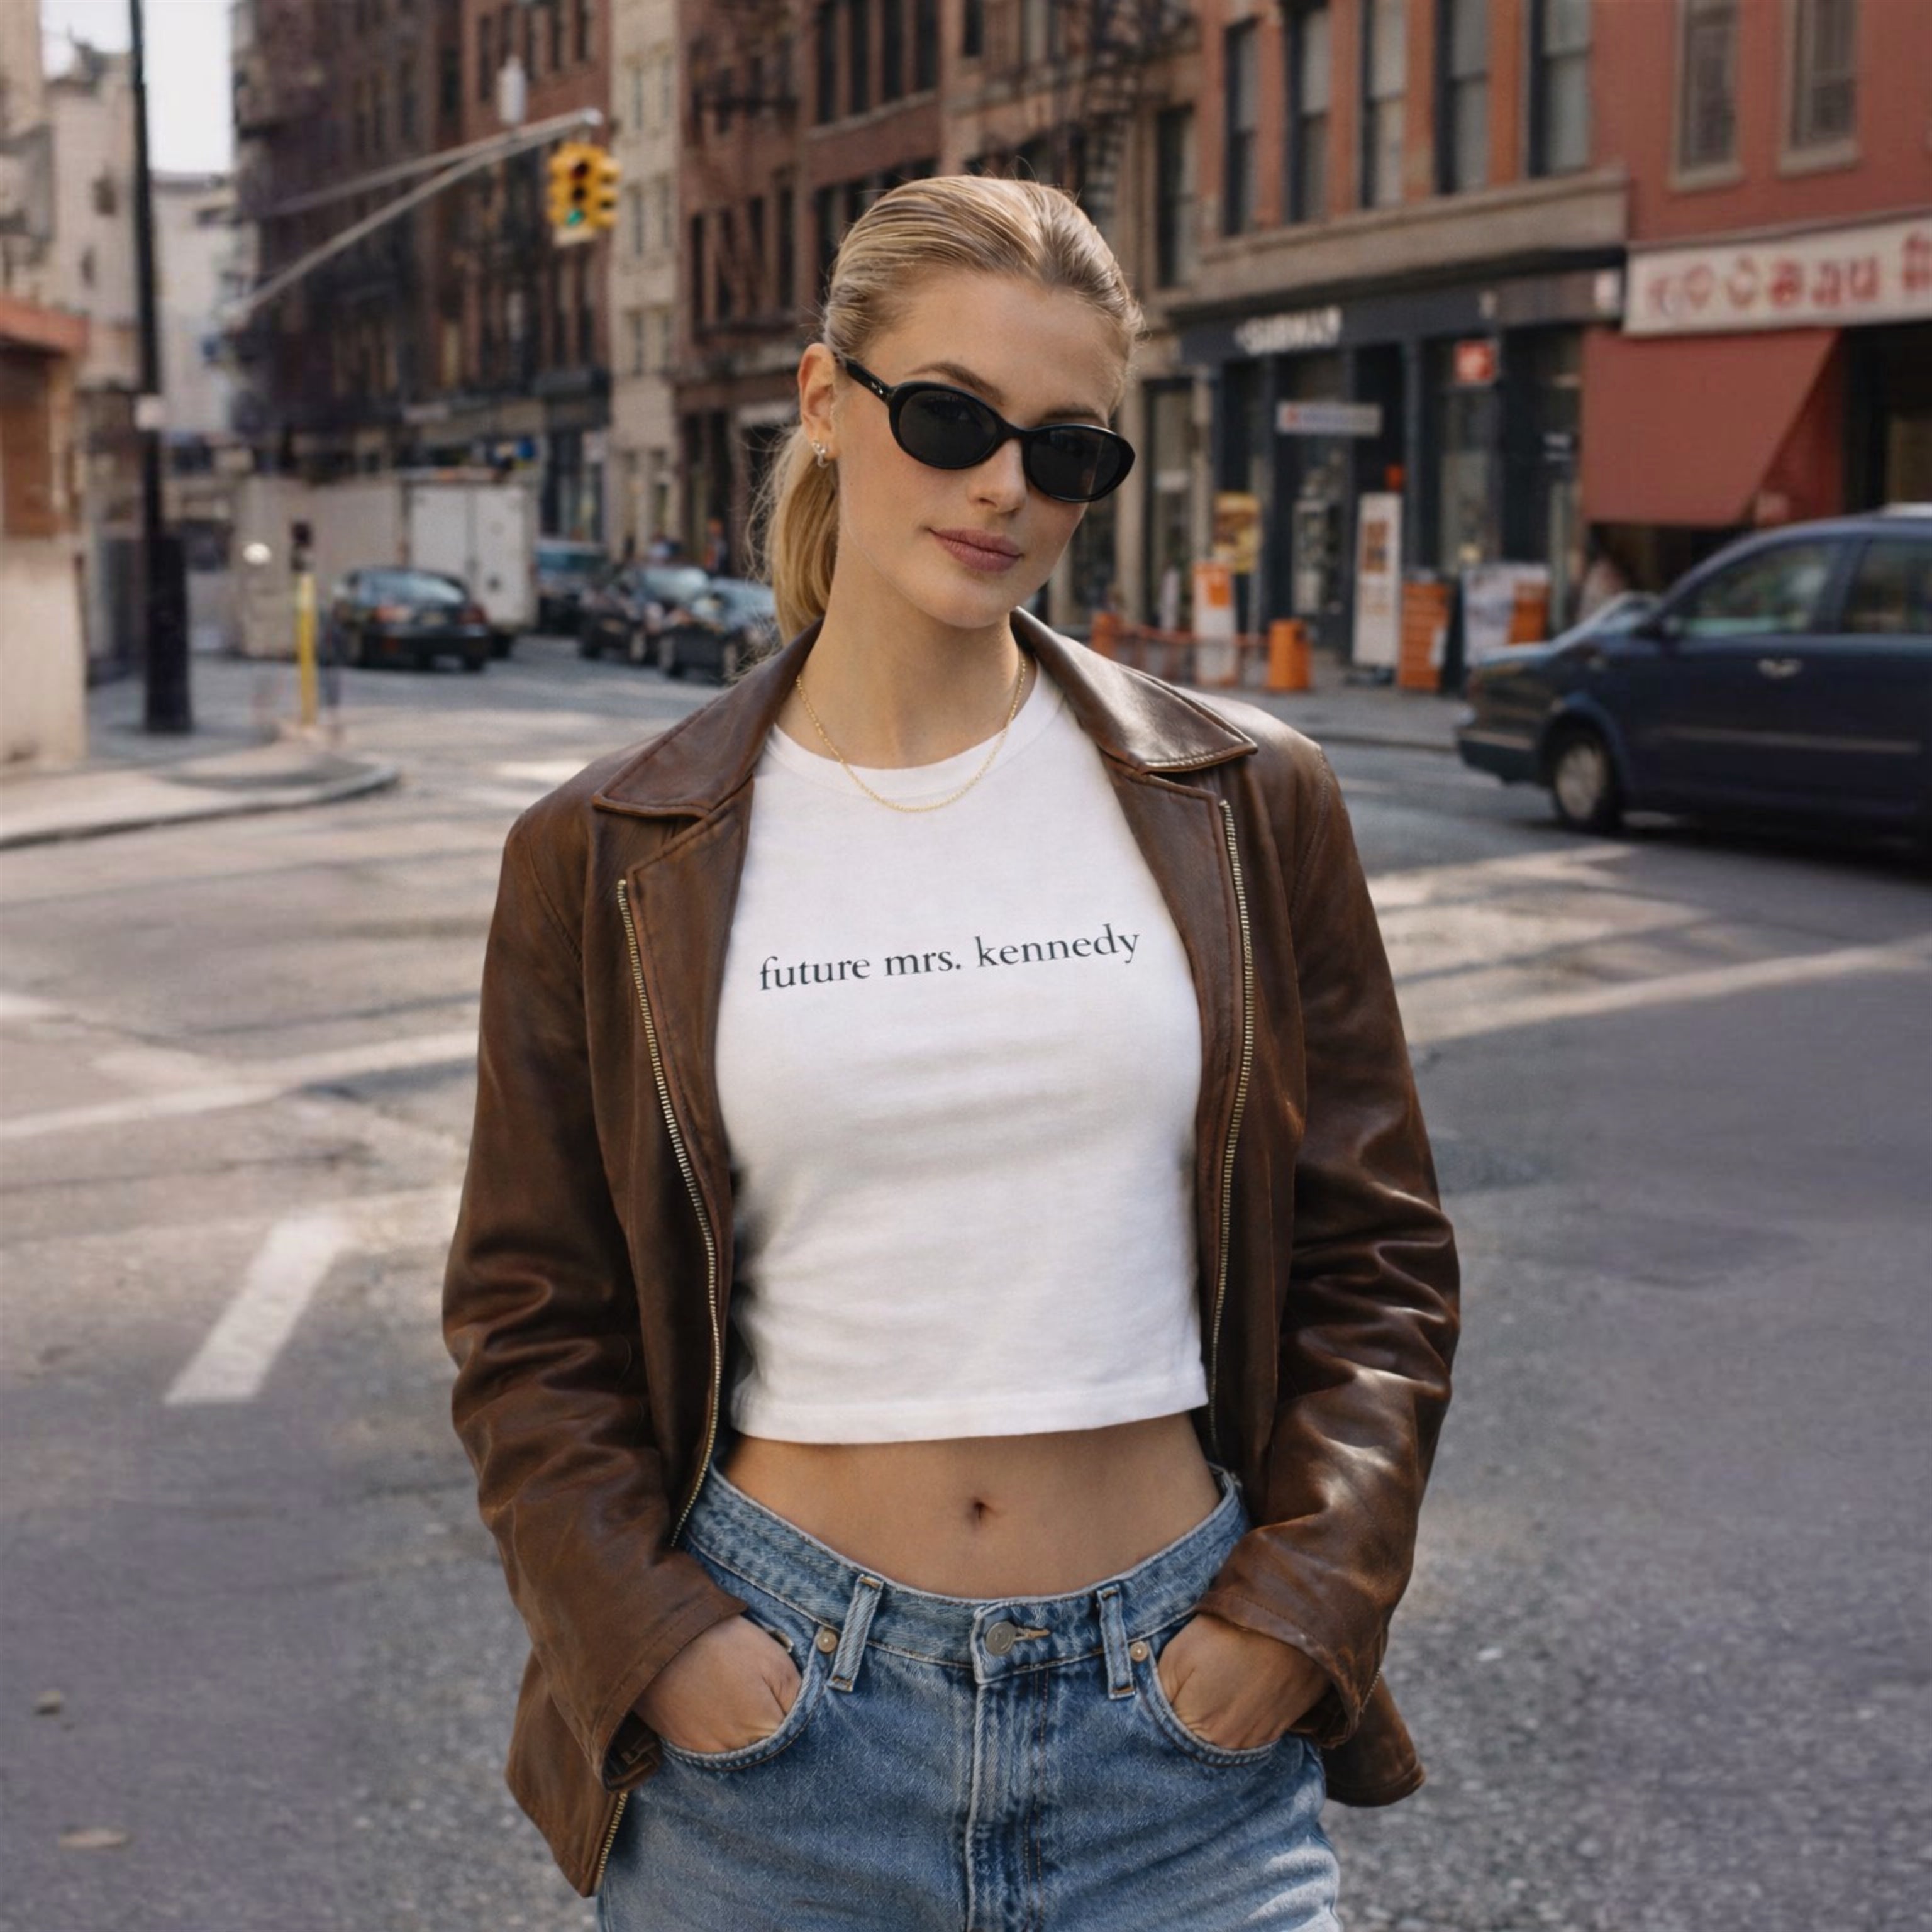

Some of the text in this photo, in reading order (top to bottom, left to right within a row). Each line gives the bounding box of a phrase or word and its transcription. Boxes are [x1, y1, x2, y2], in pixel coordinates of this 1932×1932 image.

[760, 923, 1140, 991] future mrs. kennedy
